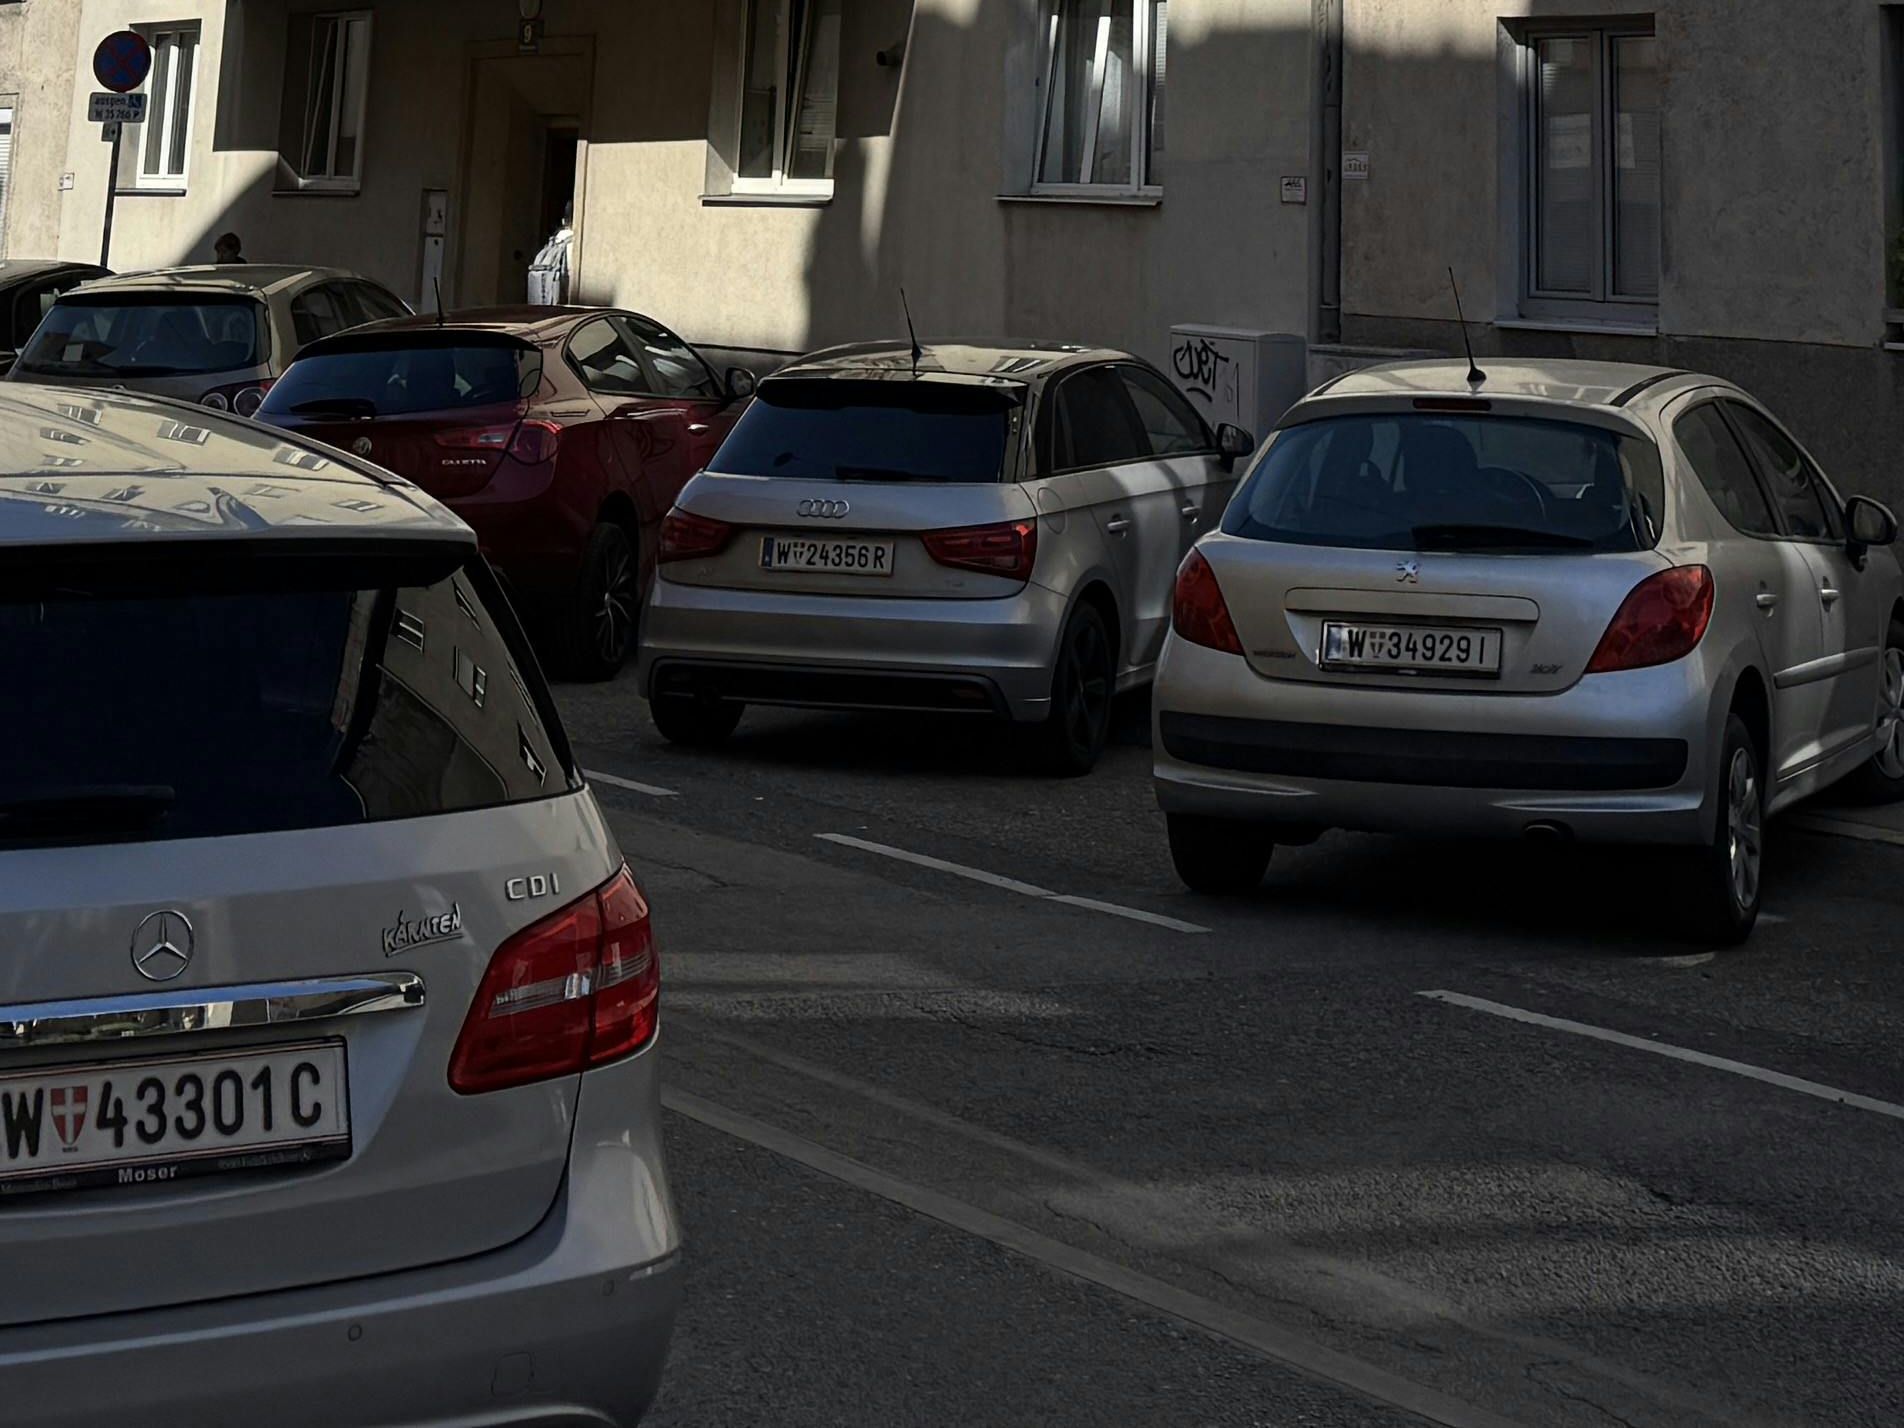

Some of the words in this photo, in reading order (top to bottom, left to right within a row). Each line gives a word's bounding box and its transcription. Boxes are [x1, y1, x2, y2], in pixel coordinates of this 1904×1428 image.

[523, 23, 532, 44] 9
[776, 542, 791, 565] W
[806, 544, 868, 568] 24356
[873, 546, 886, 570] R
[1348, 629, 1367, 659] W
[505, 873, 560, 901] CDI
[2, 1087, 44, 1160] W
[96, 1064, 272, 1148] 43301
[290, 1062, 322, 1127] C
[117, 1164, 177, 1184] Moser
